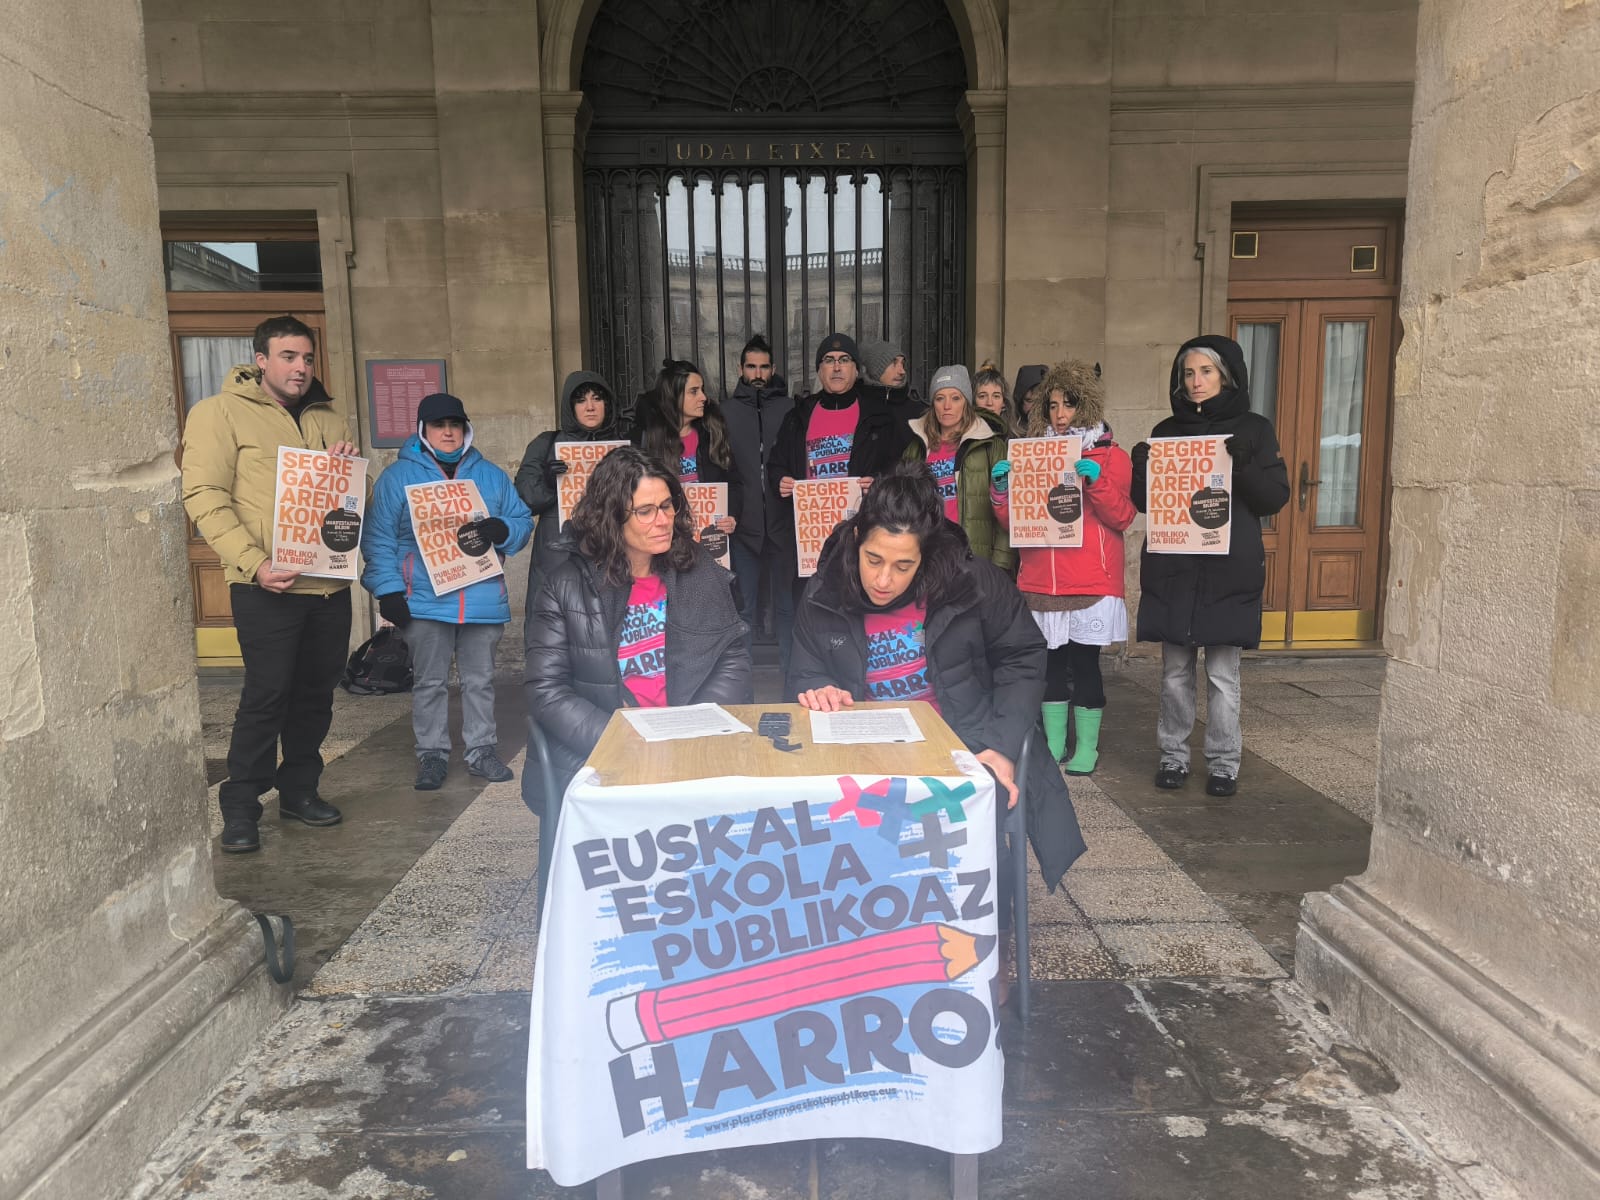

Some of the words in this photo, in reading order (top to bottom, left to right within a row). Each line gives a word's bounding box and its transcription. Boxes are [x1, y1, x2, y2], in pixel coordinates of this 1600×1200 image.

[1011, 440, 1068, 457] SEGRE
[1150, 439, 1217, 458] SEGRE
[282, 451, 353, 477] SEGRE
[809, 461, 849, 477] HARR
[1011, 456, 1065, 473] GAZIO
[1151, 457, 1214, 475] GAZIO
[281, 469, 349, 494] GAZIO
[561, 476, 585, 490] AR
[796, 481, 849, 498] SEGRE
[1012, 473, 1059, 489] AREN
[1151, 475, 1205, 492] AREN
[280, 487, 340, 511] AREN
[410, 483, 470, 505] SEGRE
[561, 491, 585, 506] KO
[686, 486, 717, 500] GRE
[1012, 489, 1049, 505] KON
[1151, 492, 1192, 509] KON
[414, 497, 473, 520] GAZIO
[690, 500, 716, 514] ZIO
[797, 496, 848, 512] GAZIO
[1013, 505, 1049, 520] TRA
[279, 505, 325, 528] KON
[418, 514, 468, 536] AREN
[799, 510, 842, 526] AREN
[1150, 509, 1191, 525] TRA
[278, 523, 320, 545] TRA
[420, 529, 459, 552] KON
[799, 526, 833, 540] KON
[1163, 537, 1186, 545] BIDEA
[277, 547, 318, 560] PUBLIKOA
[800, 540, 821, 553] TR
[277, 556, 288, 564] DA
[290, 557, 314, 567] BIDEA
[425, 545, 464, 567] TRA
[433, 564, 467, 579] PUBLIKOA
[622, 648, 666, 677] ARR
[874, 671, 930, 697] ARR
[573, 800, 831, 890] EUSKAL
[611, 843, 872, 934] ESKOLA
[652, 868, 994, 981] PUBLIKOAZ
